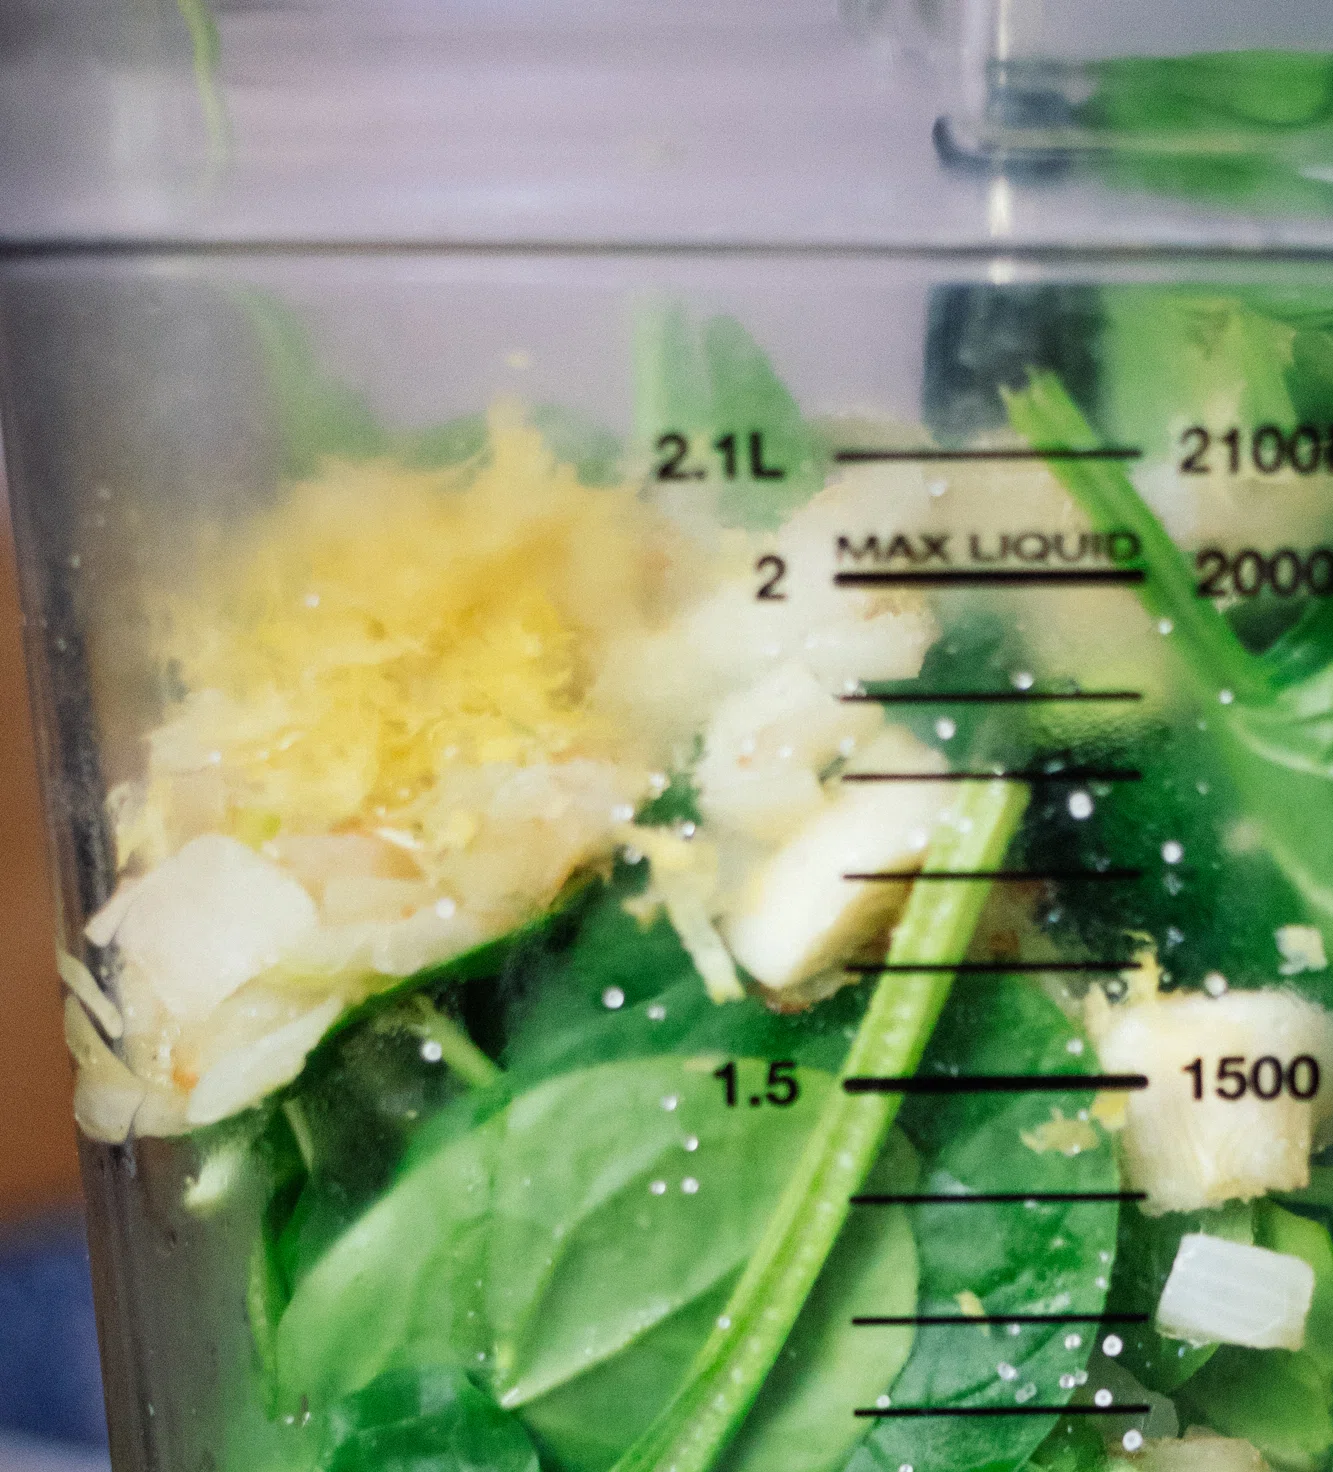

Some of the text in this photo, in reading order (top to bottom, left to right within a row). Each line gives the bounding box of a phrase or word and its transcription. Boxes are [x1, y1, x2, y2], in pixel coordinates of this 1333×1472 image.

[656, 434, 785, 479] 2.1L
[836, 532, 1141, 562] MAX LIQUID
[754, 557, 787, 600] 2
[714, 1062, 800, 1107] 1.5
[1185, 1055, 1322, 1101] 1500
